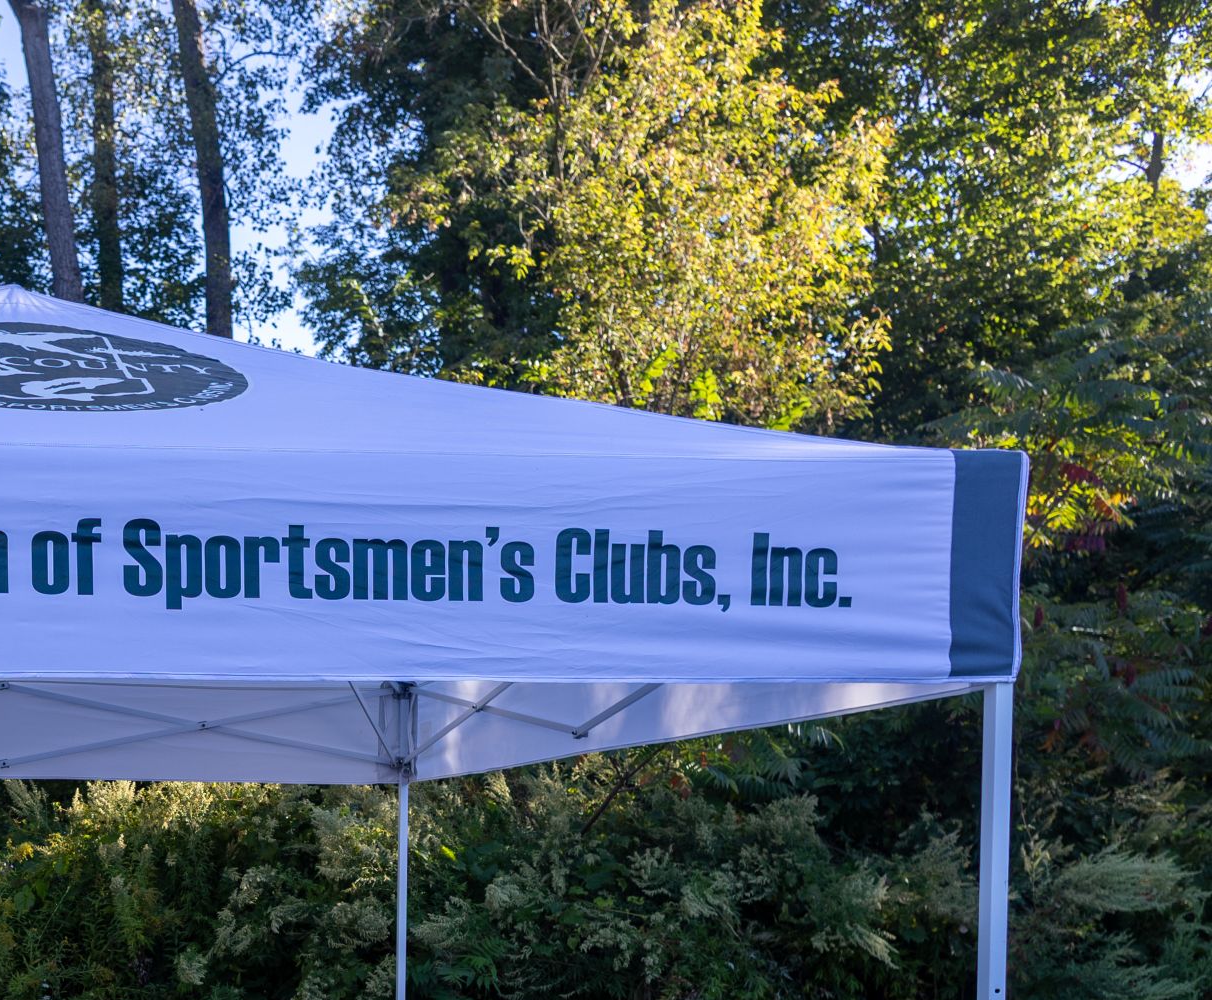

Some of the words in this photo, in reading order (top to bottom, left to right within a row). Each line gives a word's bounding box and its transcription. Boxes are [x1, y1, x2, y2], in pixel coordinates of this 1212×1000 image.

[31, 517, 102, 596] of
[122, 512, 536, 610] Sportsmen's
[554, 527, 732, 613] Clubs,
[750, 532, 853, 608] Inc.
